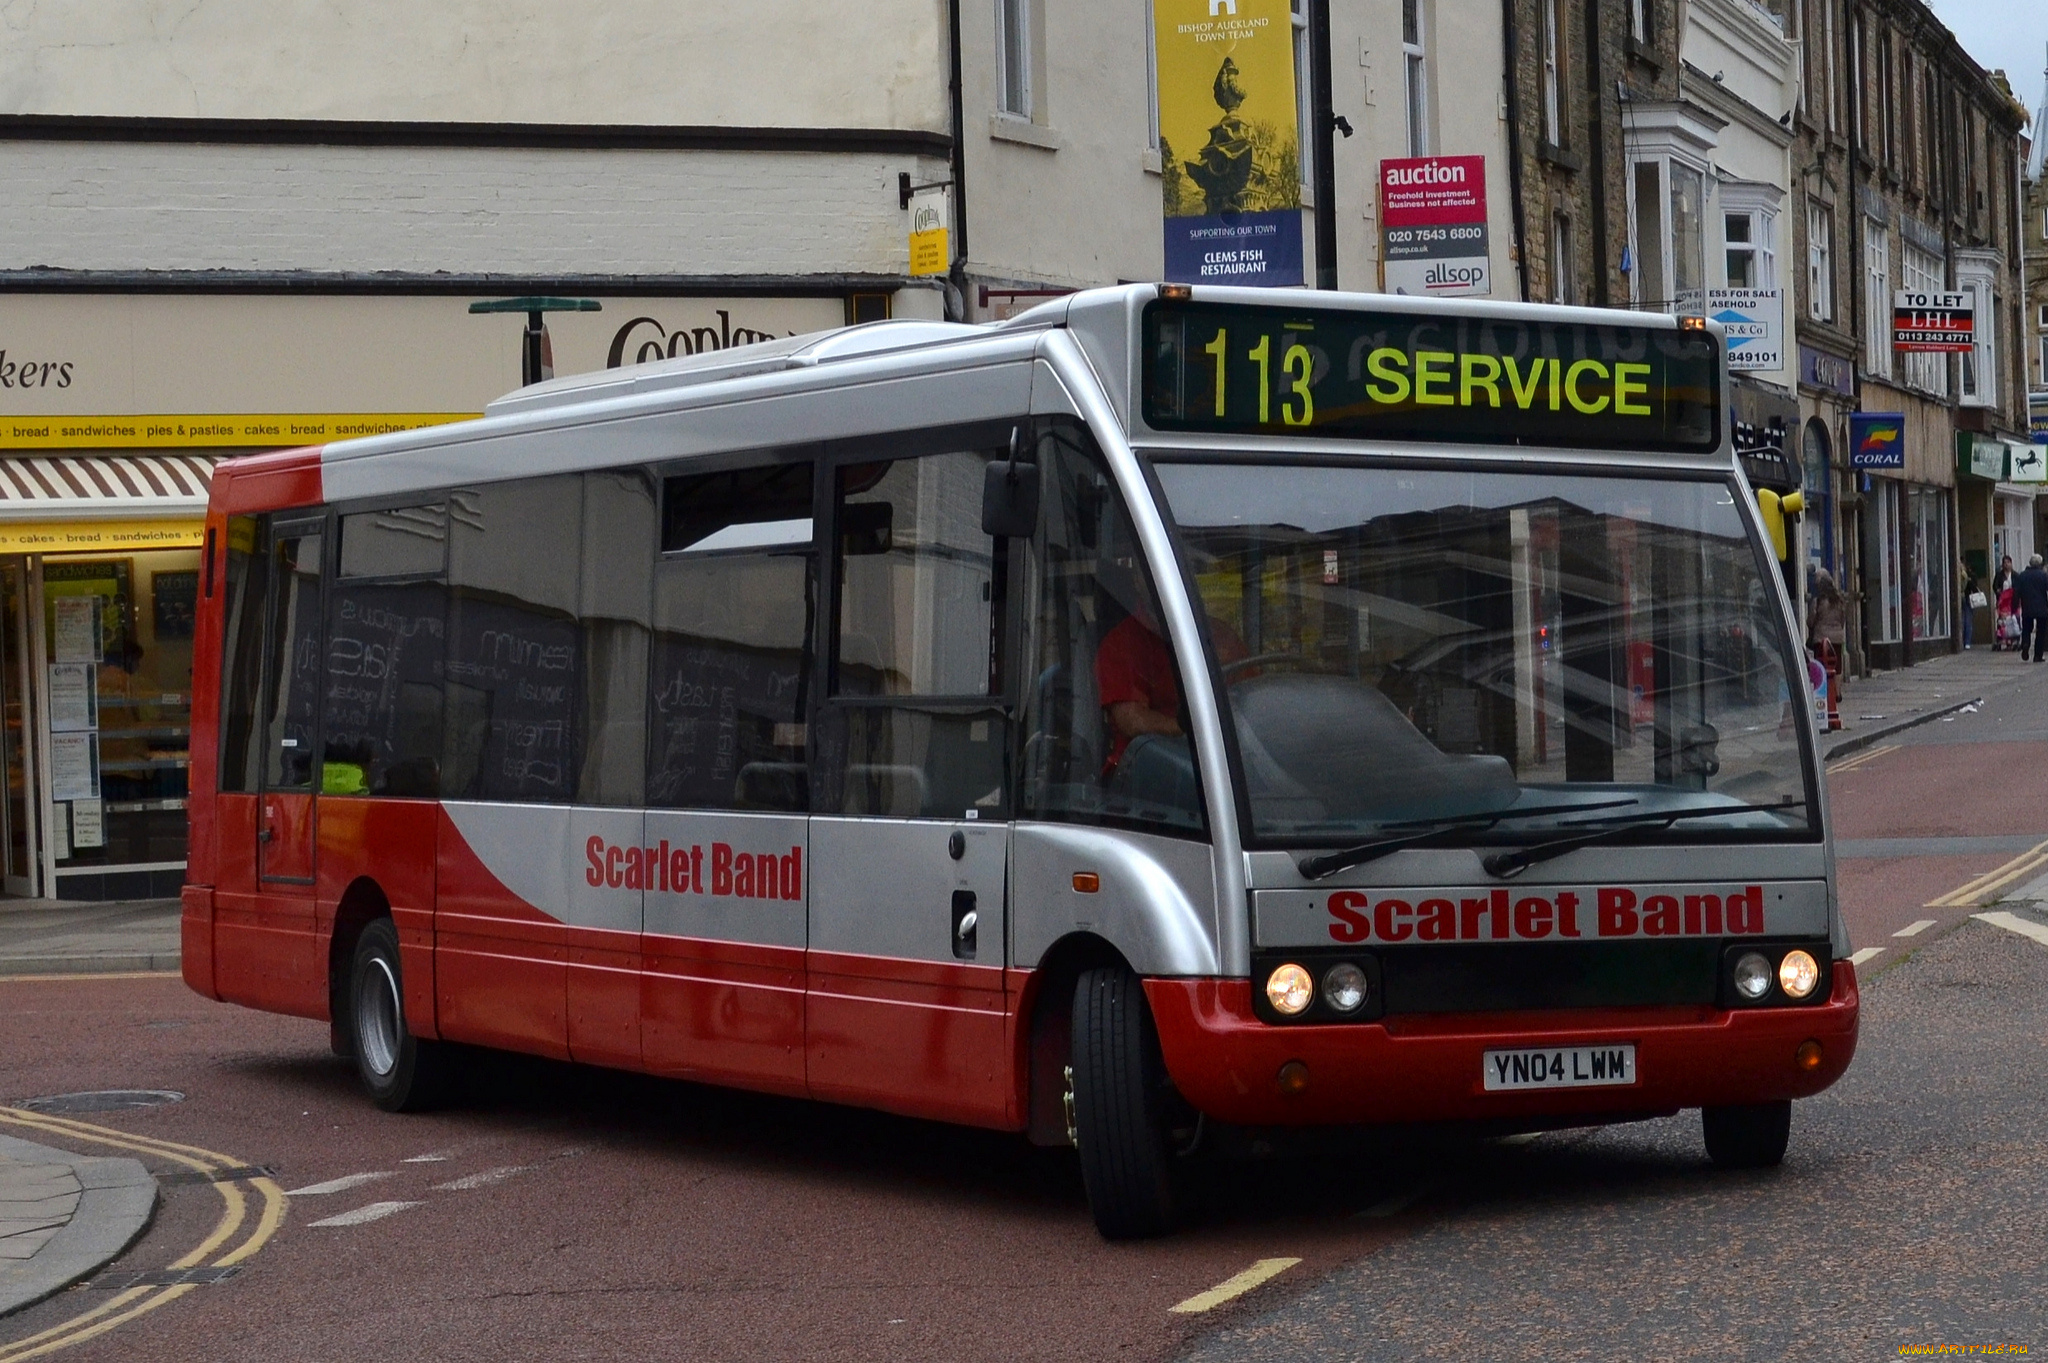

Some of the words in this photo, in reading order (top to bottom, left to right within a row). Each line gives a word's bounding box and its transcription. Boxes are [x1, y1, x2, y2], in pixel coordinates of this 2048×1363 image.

[1177, 22, 1214, 33] BISHOP
[1217, 18, 1269, 31] AUCKLAND
[1195, 31, 1226, 42] TOWN
[1228, 30, 1254, 39] TEAM
[1386, 161, 1466, 186] auction
[1388, 192, 1424, 200] Freehold
[1388, 201, 1426, 209] Business
[1442, 198, 1476, 206] affected
[1189, 227, 1236, 239] SUPPORTING
[1236, 226, 1254, 235] OUR
[1254, 224, 1277, 234] TOWN
[1388, 231, 1413, 243] 020
[1416, 229, 1447, 241] 7543
[1450, 227, 1482, 239] 6800
[1204, 251, 1238, 264] CLEMS
[1240, 249, 1263, 261] FISH
[1389, 244, 1429, 254] allsop.co.uk
[1200, 261, 1267, 276] RESTAURANT
[1425, 263, 1484, 287] allsop
[1730, 290, 1750, 298] FOR
[1752, 290, 1777, 298] SALE
[1905, 294, 1927, 306] TO
[1933, 295, 1963, 307] LET
[1910, 311, 1957, 329] LHL
[1738, 325, 1746, 335] &
[1749, 325, 1763, 335] Co
[1898, 332, 1923, 341] 0113
[1925, 333, 1944, 342] 243
[1945, 334, 1969, 342] 4771
[1728, 352, 1777, 362] 849101
[1366, 347, 1651, 416] SERVICE
[13, 426, 50, 438] bread
[61, 424, 136, 437] sandwiches
[147, 424, 173, 438] pies
[177, 424, 186, 436] &
[190, 423, 234, 438] pasties
[244, 424, 280, 436] cakes
[290, 423, 325, 435] bread
[1854, 454, 1901, 464] CORAL
[19, 534, 56, 544] cakes
[66, 532, 102, 543] bread
[112, 531, 182, 542] sandwiches
[585, 835, 704, 894] Scarlet
[711, 842, 803, 900] Band
[1327, 889, 1581, 943] Scarlet
[1597, 886, 1765, 937] Band
[1494, 1053, 1566, 1083] YN04
[1573, 1050, 1625, 1080] LWM
